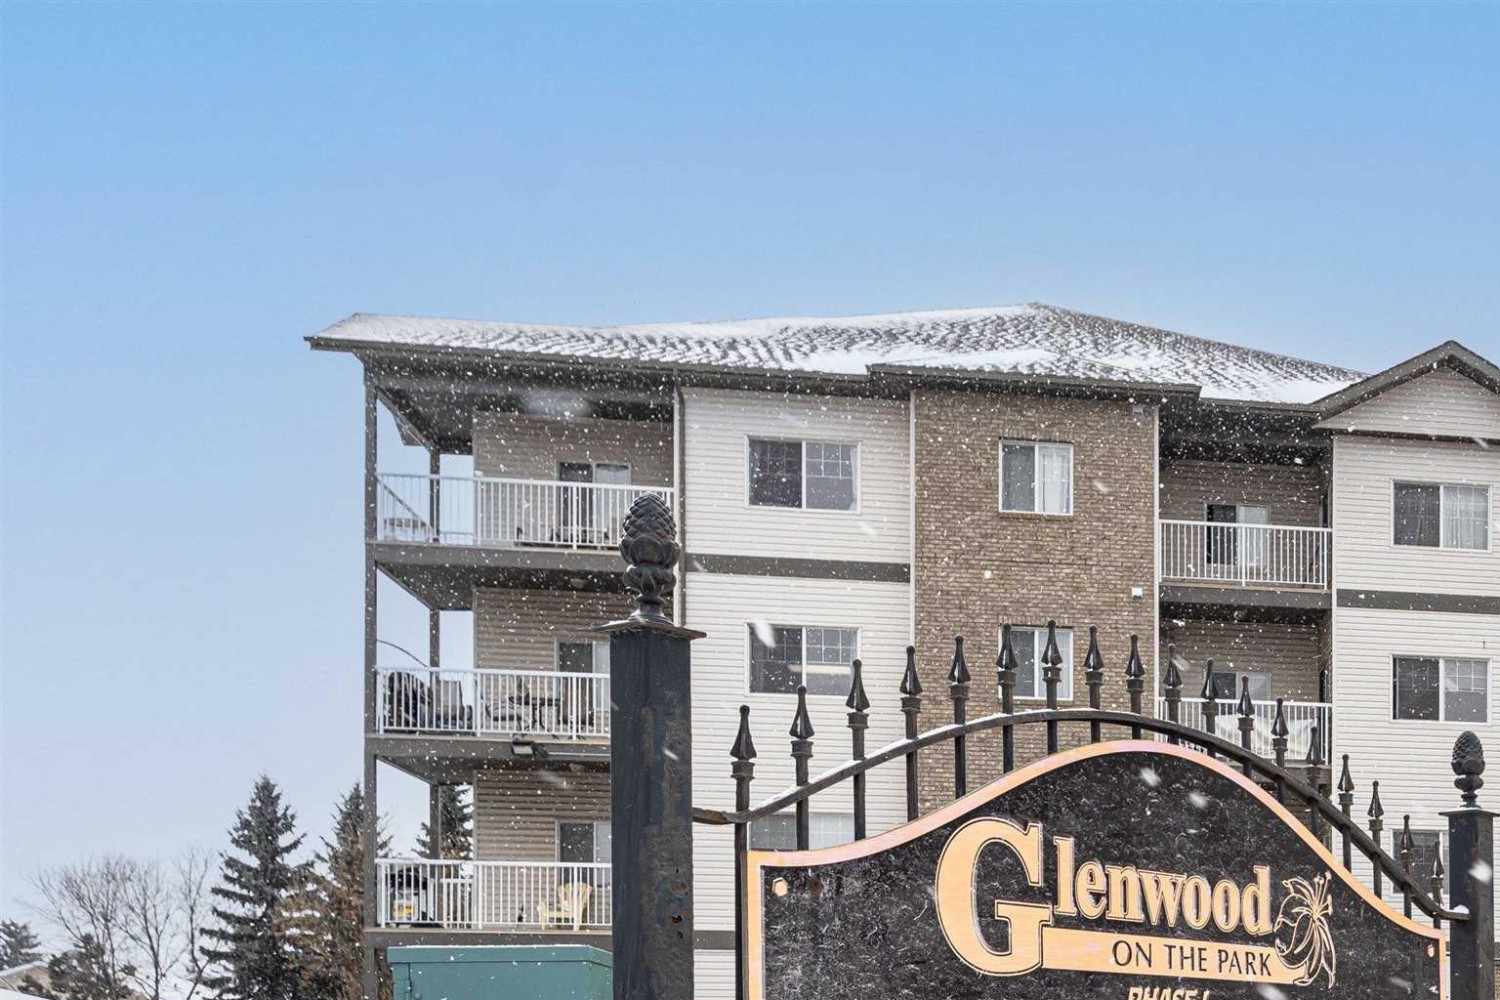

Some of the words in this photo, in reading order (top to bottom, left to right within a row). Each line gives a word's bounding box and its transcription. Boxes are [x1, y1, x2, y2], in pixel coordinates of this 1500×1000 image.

[935, 817, 1273, 976] Glenwood
[1112, 940, 1151, 968] ON
[1164, 944, 1208, 972] THE
[1218, 949, 1272, 976] PARK
